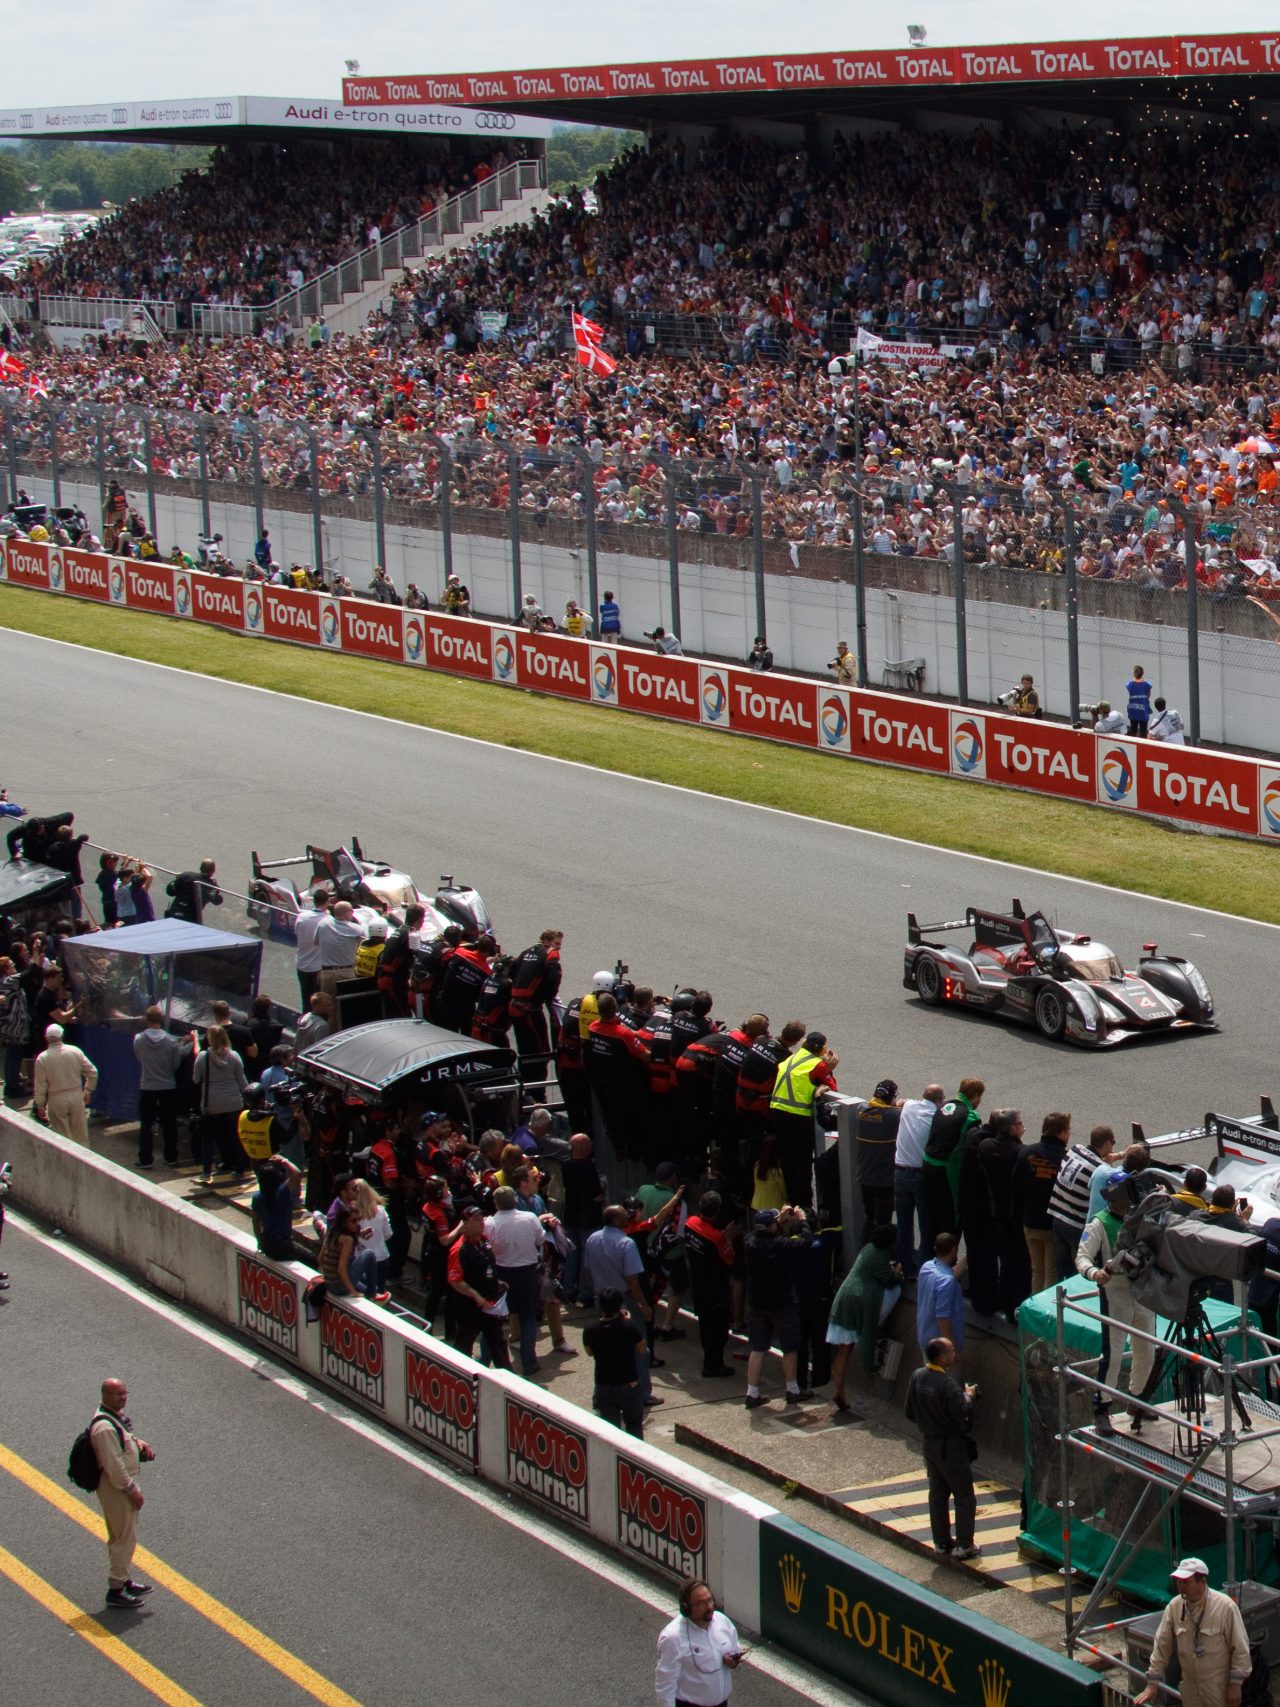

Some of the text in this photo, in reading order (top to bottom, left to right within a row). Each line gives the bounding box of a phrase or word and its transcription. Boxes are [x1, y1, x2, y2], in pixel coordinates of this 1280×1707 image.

[347, 83, 380, 100] TOTAL
[386, 82, 421, 99] TOTAL
[427, 80, 463, 98] TOTAL
[468, 79, 507, 96] TOTAL
[514, 76, 554, 94] TOTAL
[561, 74, 604, 91] TOTAL
[610, 71, 654, 89] TOTAL
[662, 68, 708, 87] TOTAL
[717, 65, 765, 84] TOTAL
[774, 62, 824, 82] TOTAL
[833, 59, 886, 79] TOTAL
[896, 56, 952, 77] TOTAL
[962, 54, 1021, 75] TOTAL
[1032, 50, 1093, 72] TOTAL
[1105, 46, 1171, 70] TOTAL
[1181, 42, 1249, 67] TOTAL
[46, 114, 61, 126] Audi
[83, 113, 108, 126] quattro
[140, 108, 209, 121] Audi e-tron quattro
[285, 105, 463, 126] Audi e-tron quattro
[10, 550, 46, 577] TOTAL
[67, 560, 106, 587] TOTAL
[129, 572, 171, 600] TOTAL
[195, 585, 240, 615] TOTAL
[267, 598, 316, 630] TOTAL
[345, 613, 398, 646] TOTAL
[430, 628, 487, 664] TOTAL
[522, 645, 585, 684] TOTAL
[624, 665, 694, 704] TOTAL
[736, 685, 811, 728] TOTAL
[858, 708, 942, 753] TOTAL
[995, 734, 1088, 782] TOTAL
[1146, 761, 1250, 815] TOTAL
[980, 917, 1010, 932] Audi ultra
[953, 985, 963, 1000] 4
[1137, 997, 1156, 1008] 4
[1222, 1126, 1241, 1139] Audi
[1242, 1132, 1267, 1147] e-tron
[239, 1258, 297, 1328] MOTO
[321, 1303, 383, 1377] MOTO
[407, 1352, 475, 1430] MOTO
[508, 1402, 587, 1487] MOTO
[619, 1461, 704, 1551] MOTO
[826, 1584, 956, 1694] ROLEX
